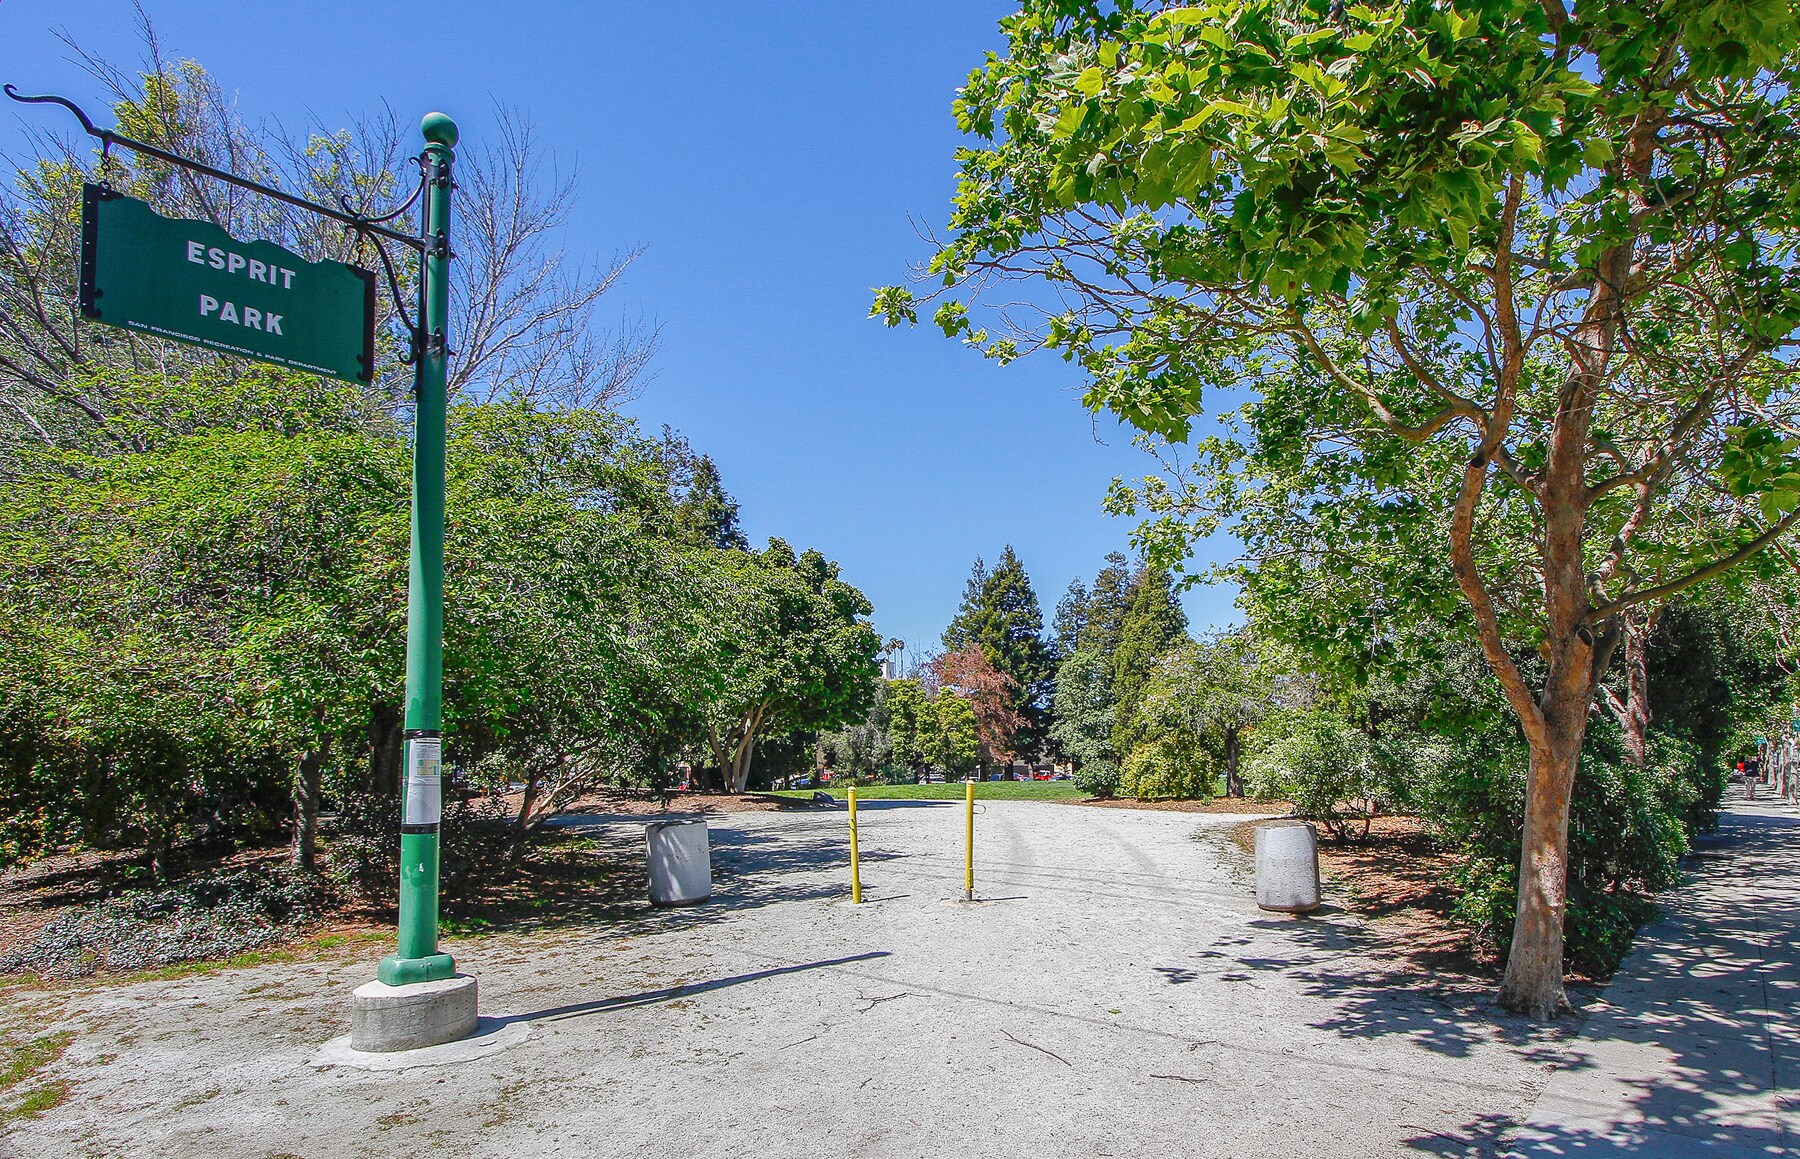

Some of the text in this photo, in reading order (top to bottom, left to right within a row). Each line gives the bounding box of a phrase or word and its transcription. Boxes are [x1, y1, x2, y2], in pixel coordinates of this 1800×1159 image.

[187, 240, 296, 289] ESPRIT
[200, 294, 283, 335] PARK
[128, 320, 148, 329] SAN
[150, 325, 201, 342] FRANCISCO
[203, 339, 254, 355] RECREATION
[265, 353, 286, 363] PARK
[288, 359, 337, 375] DEPARTMENT
